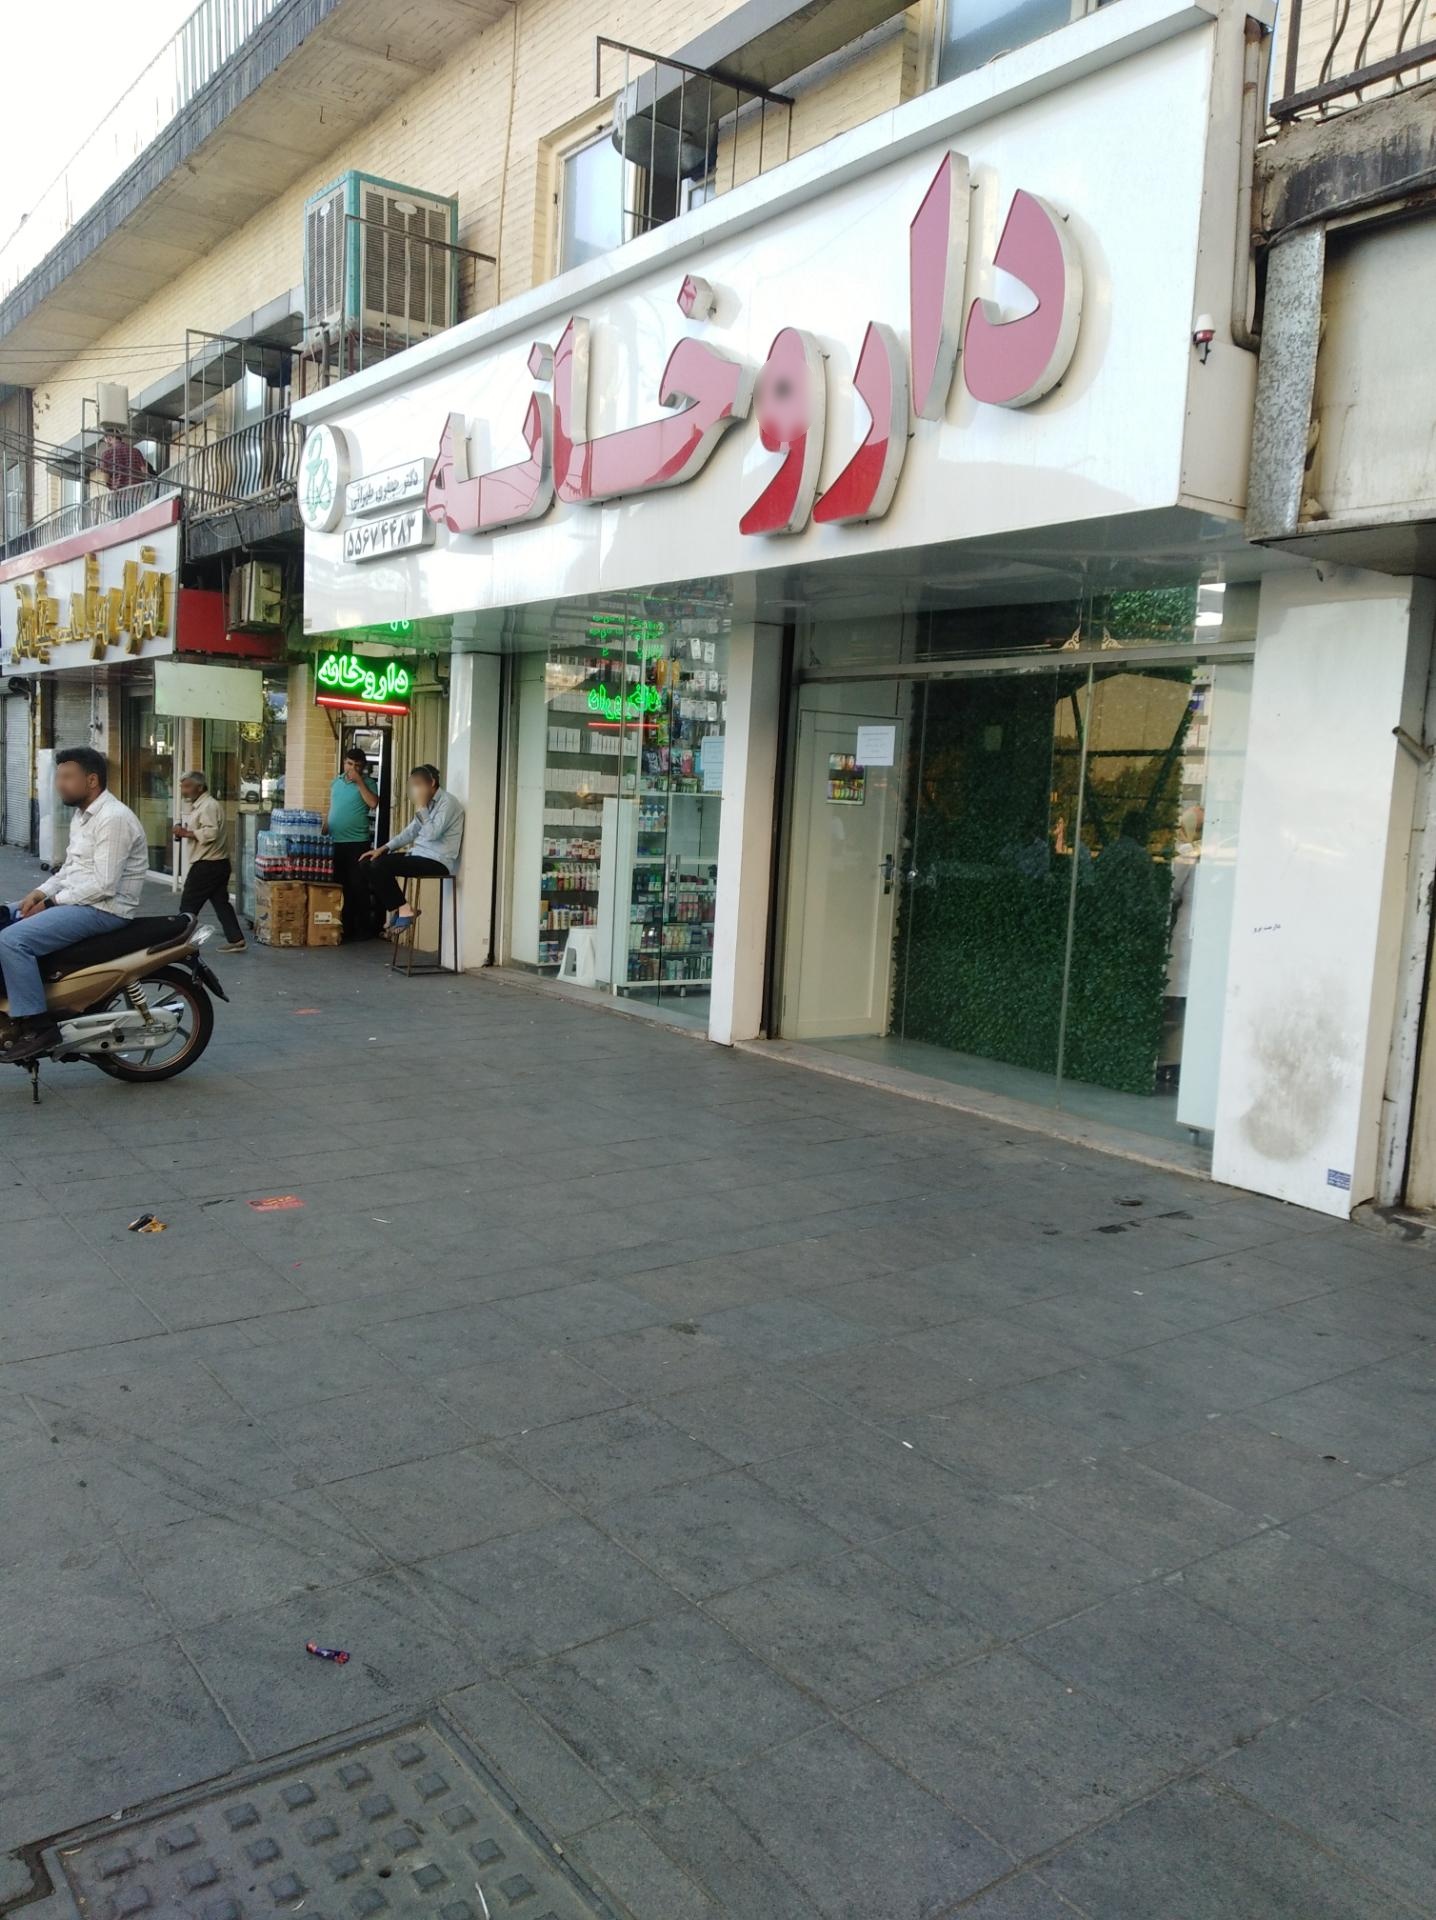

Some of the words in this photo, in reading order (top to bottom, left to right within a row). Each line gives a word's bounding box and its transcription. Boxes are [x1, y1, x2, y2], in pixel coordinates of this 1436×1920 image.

[426, 151, 1082, 536] داروخانه
[403, 468, 418, 494] دکتر
[347, 515, 415, 556] ۵۵۶۷۴۴۸۳
[317, 654, 409, 701] داروخانه
